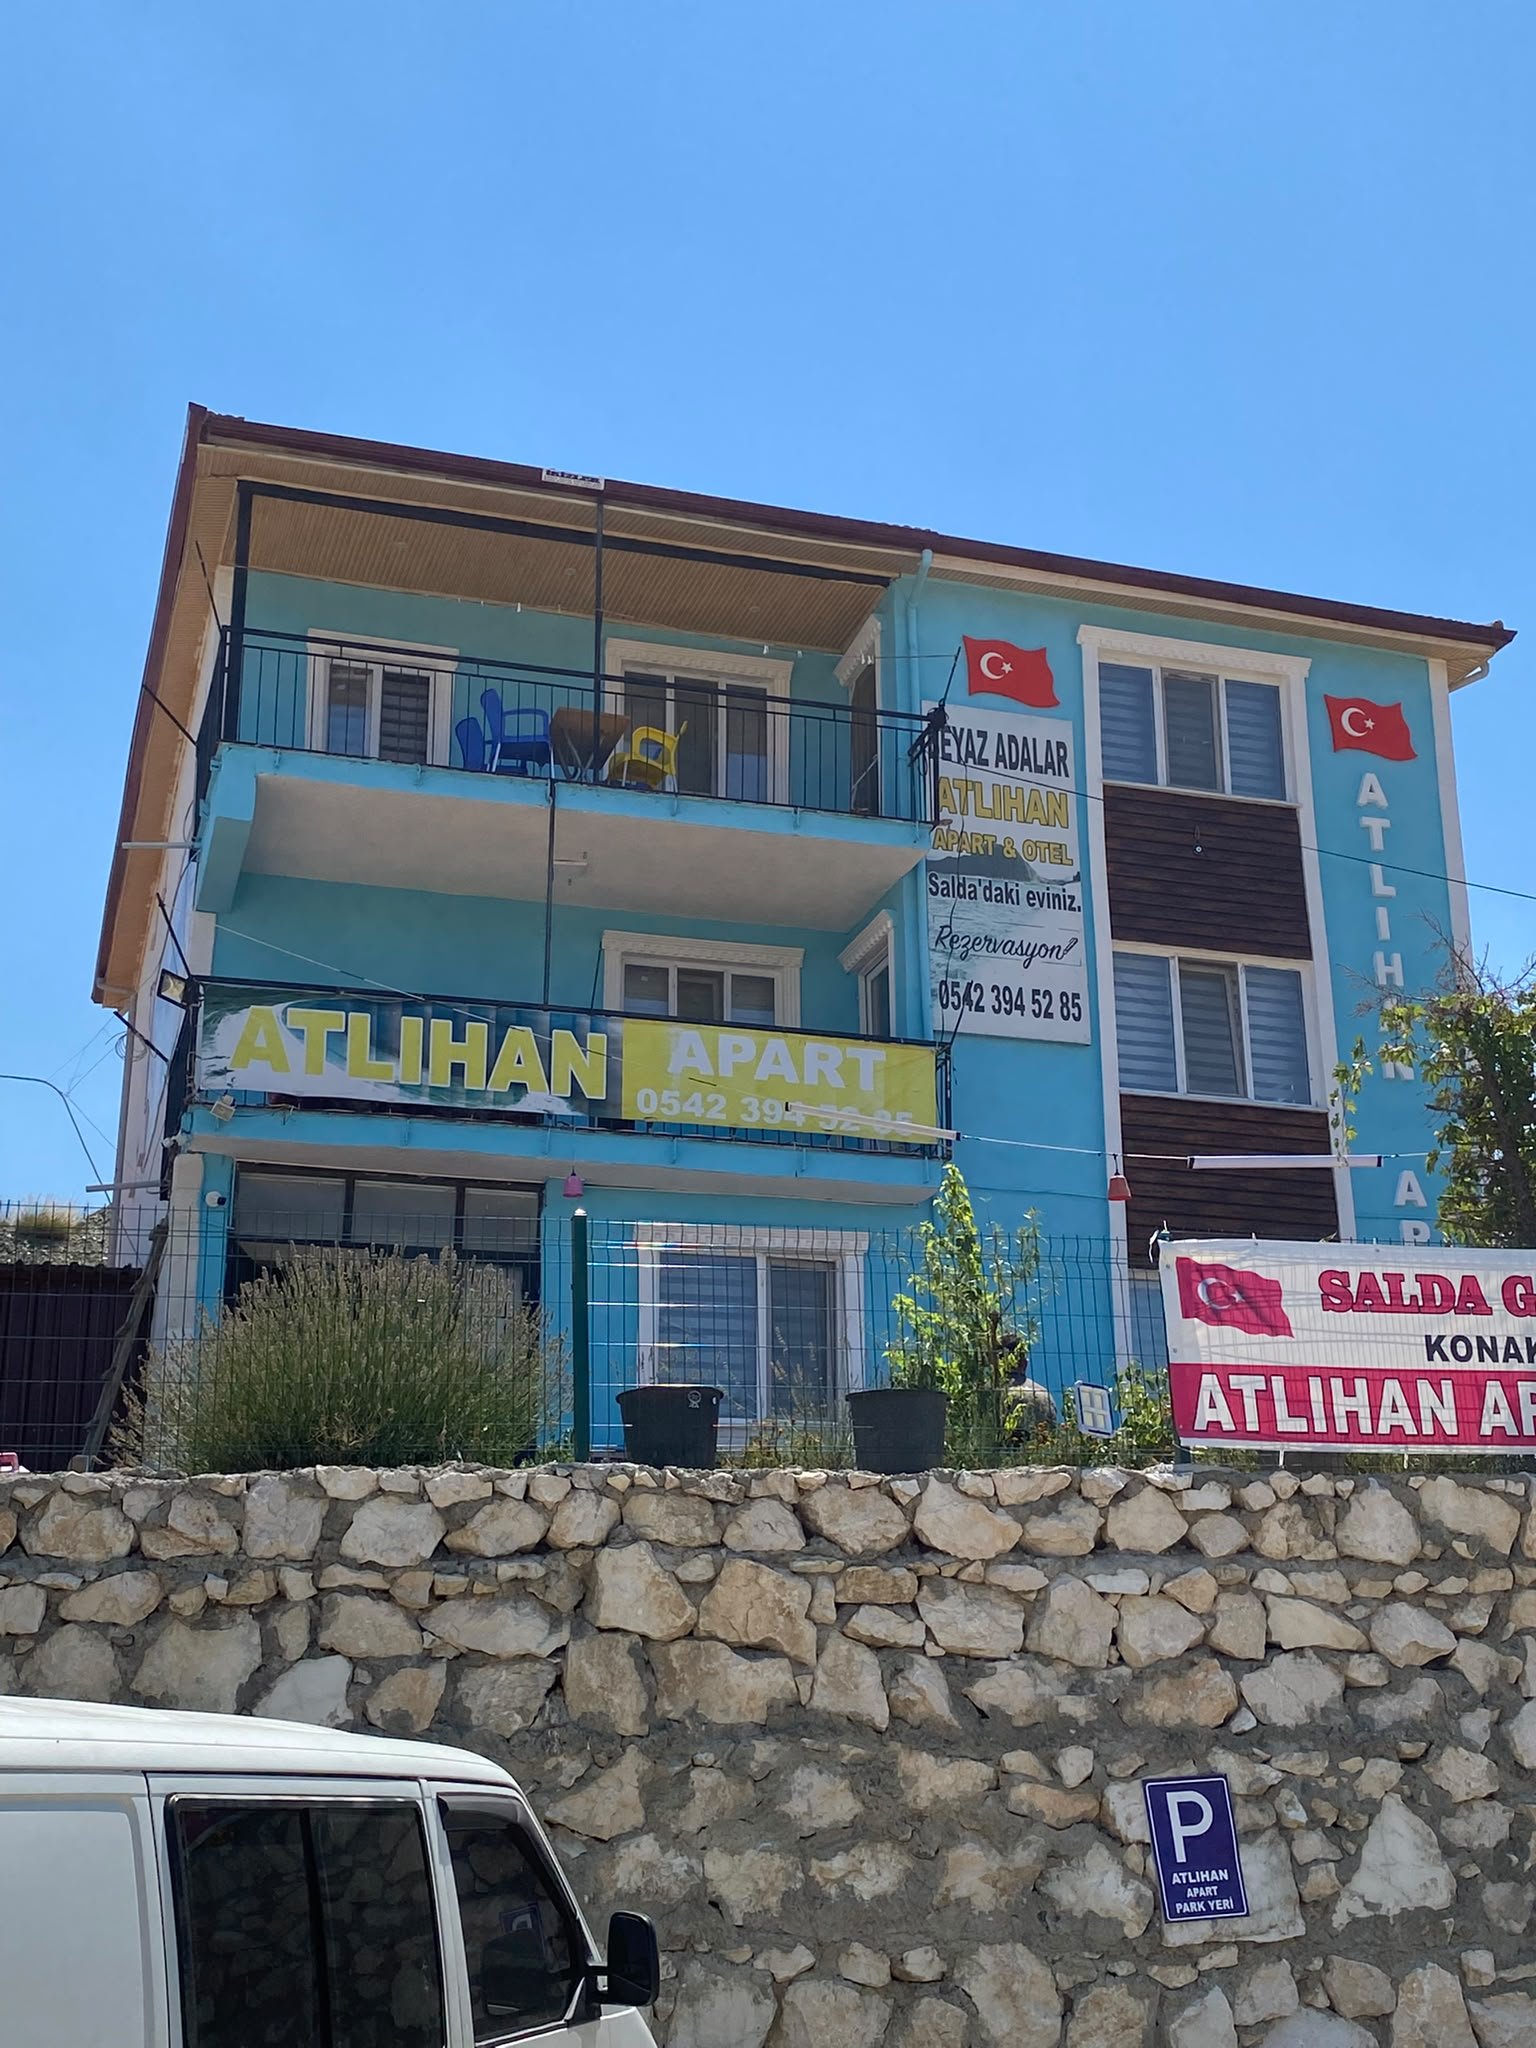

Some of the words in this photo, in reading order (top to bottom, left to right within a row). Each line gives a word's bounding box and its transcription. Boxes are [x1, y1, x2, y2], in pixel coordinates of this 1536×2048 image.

[929, 725, 989, 766] EYAZ
[994, 732, 1070, 777] ADALAR
[938, 776, 1069, 829] ATLIHAN
[933, 827, 997, 856] APART
[1003, 836, 1016, 859] &
[1022, 839, 1074, 866] OTEL
[928, 871, 1021, 906] Salda'daki
[1026, 886, 1082, 912] eviniz.
[935, 925, 1066, 969] Rezervasyon
[939, 979, 985, 1013] 0542
[991, 984, 1025, 1017] 394
[1031, 988, 1054, 1020] 52
[1059, 990, 1082, 1022] 85
[229, 1004, 608, 1100] ATLIHAN
[667, 1030, 886, 1092] APART
[636, 1087, 727, 1121] 0542
[740, 1096, 806, 1127] 394
[1318, 1269, 1493, 1316] SALDA
[1193, 1373, 1459, 1437] ATLIHAN
[1166, 1790, 1213, 1863] P
[1172, 1869, 1229, 1885] ATLIHAN
[1187, 1886, 1218, 1898] APART
[1175, 1900, 1206, 1914] PARK
[1208, 1896, 1235, 1910] YERİ
